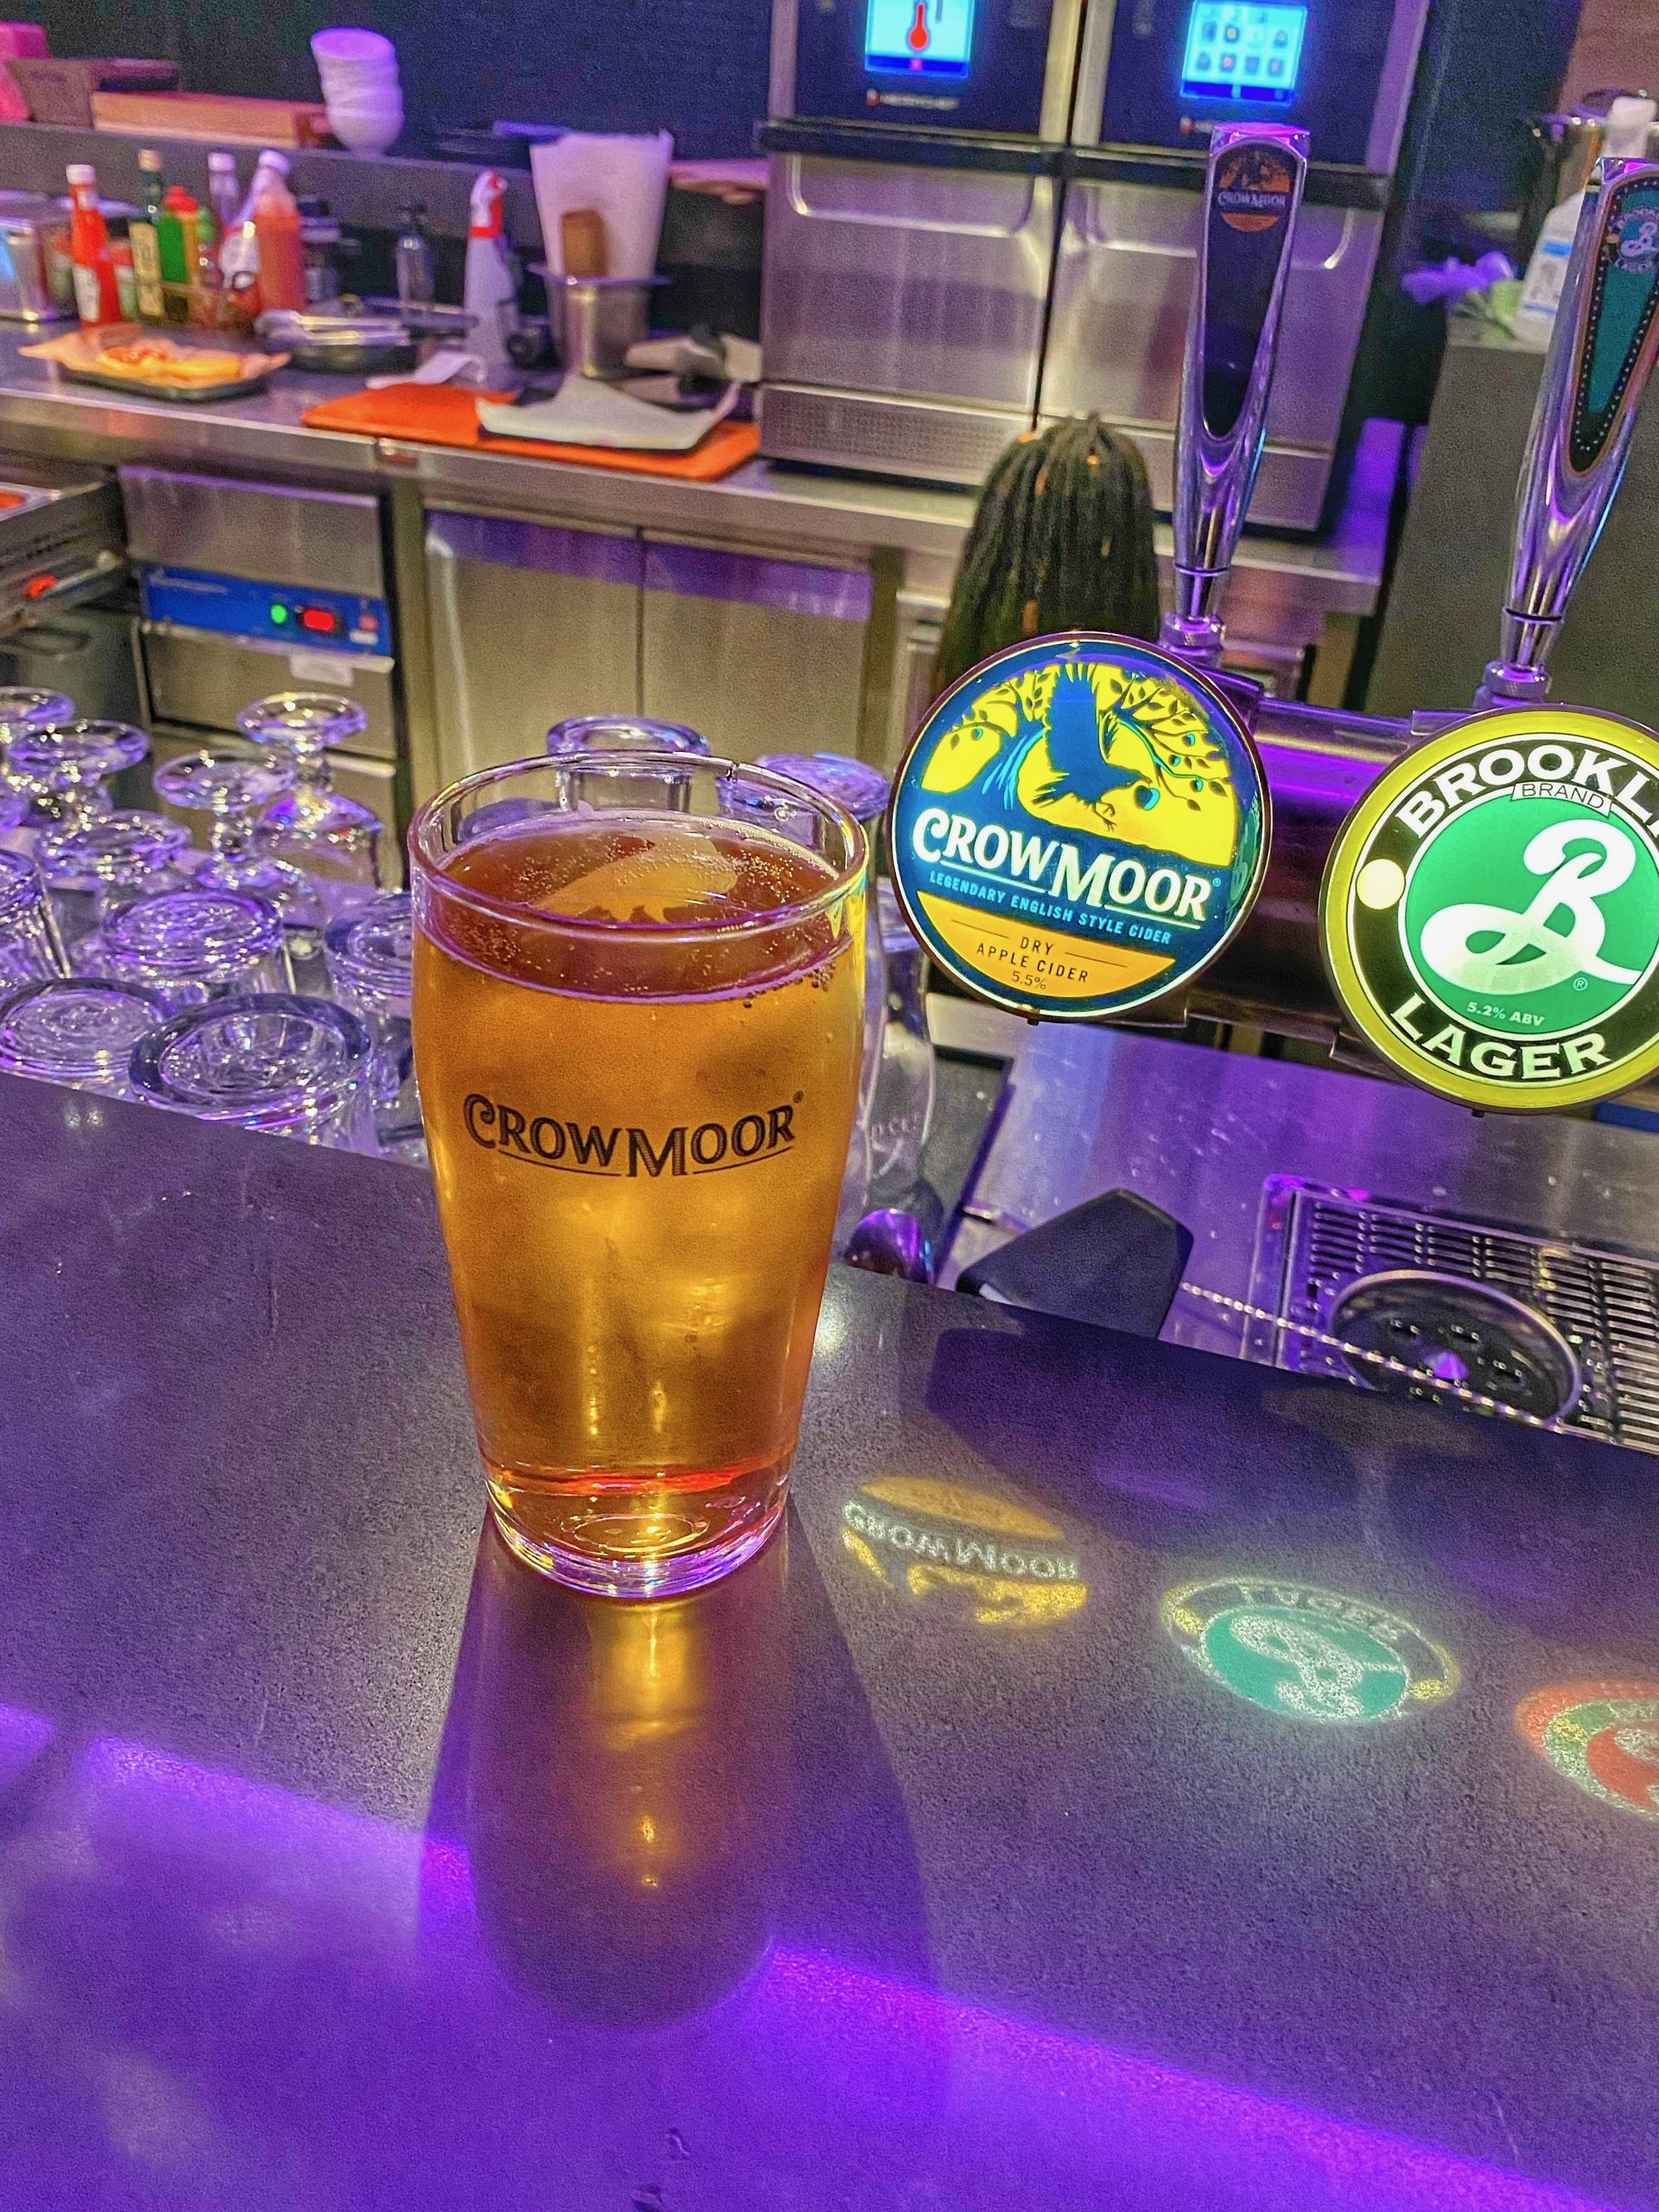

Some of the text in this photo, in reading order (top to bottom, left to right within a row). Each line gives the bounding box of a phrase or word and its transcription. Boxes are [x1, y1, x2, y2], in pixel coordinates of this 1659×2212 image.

[1395, 744, 1659, 838] BROOKL
[1522, 783, 1605, 809] BRAND
[912, 807, 1211, 922] CROWMOOR
[930, 870, 1172, 944] LEGENDARY ENGLISH STYLE CIDER
[976, 943, 1090, 982] APPLE CIDER
[1020, 936, 1054, 956] DRY
[1011, 970, 1047, 990] 5.5%
[1466, 1001, 1545, 1027] 5.2% ABV
[1390, 993, 1612, 1079] LAGER
